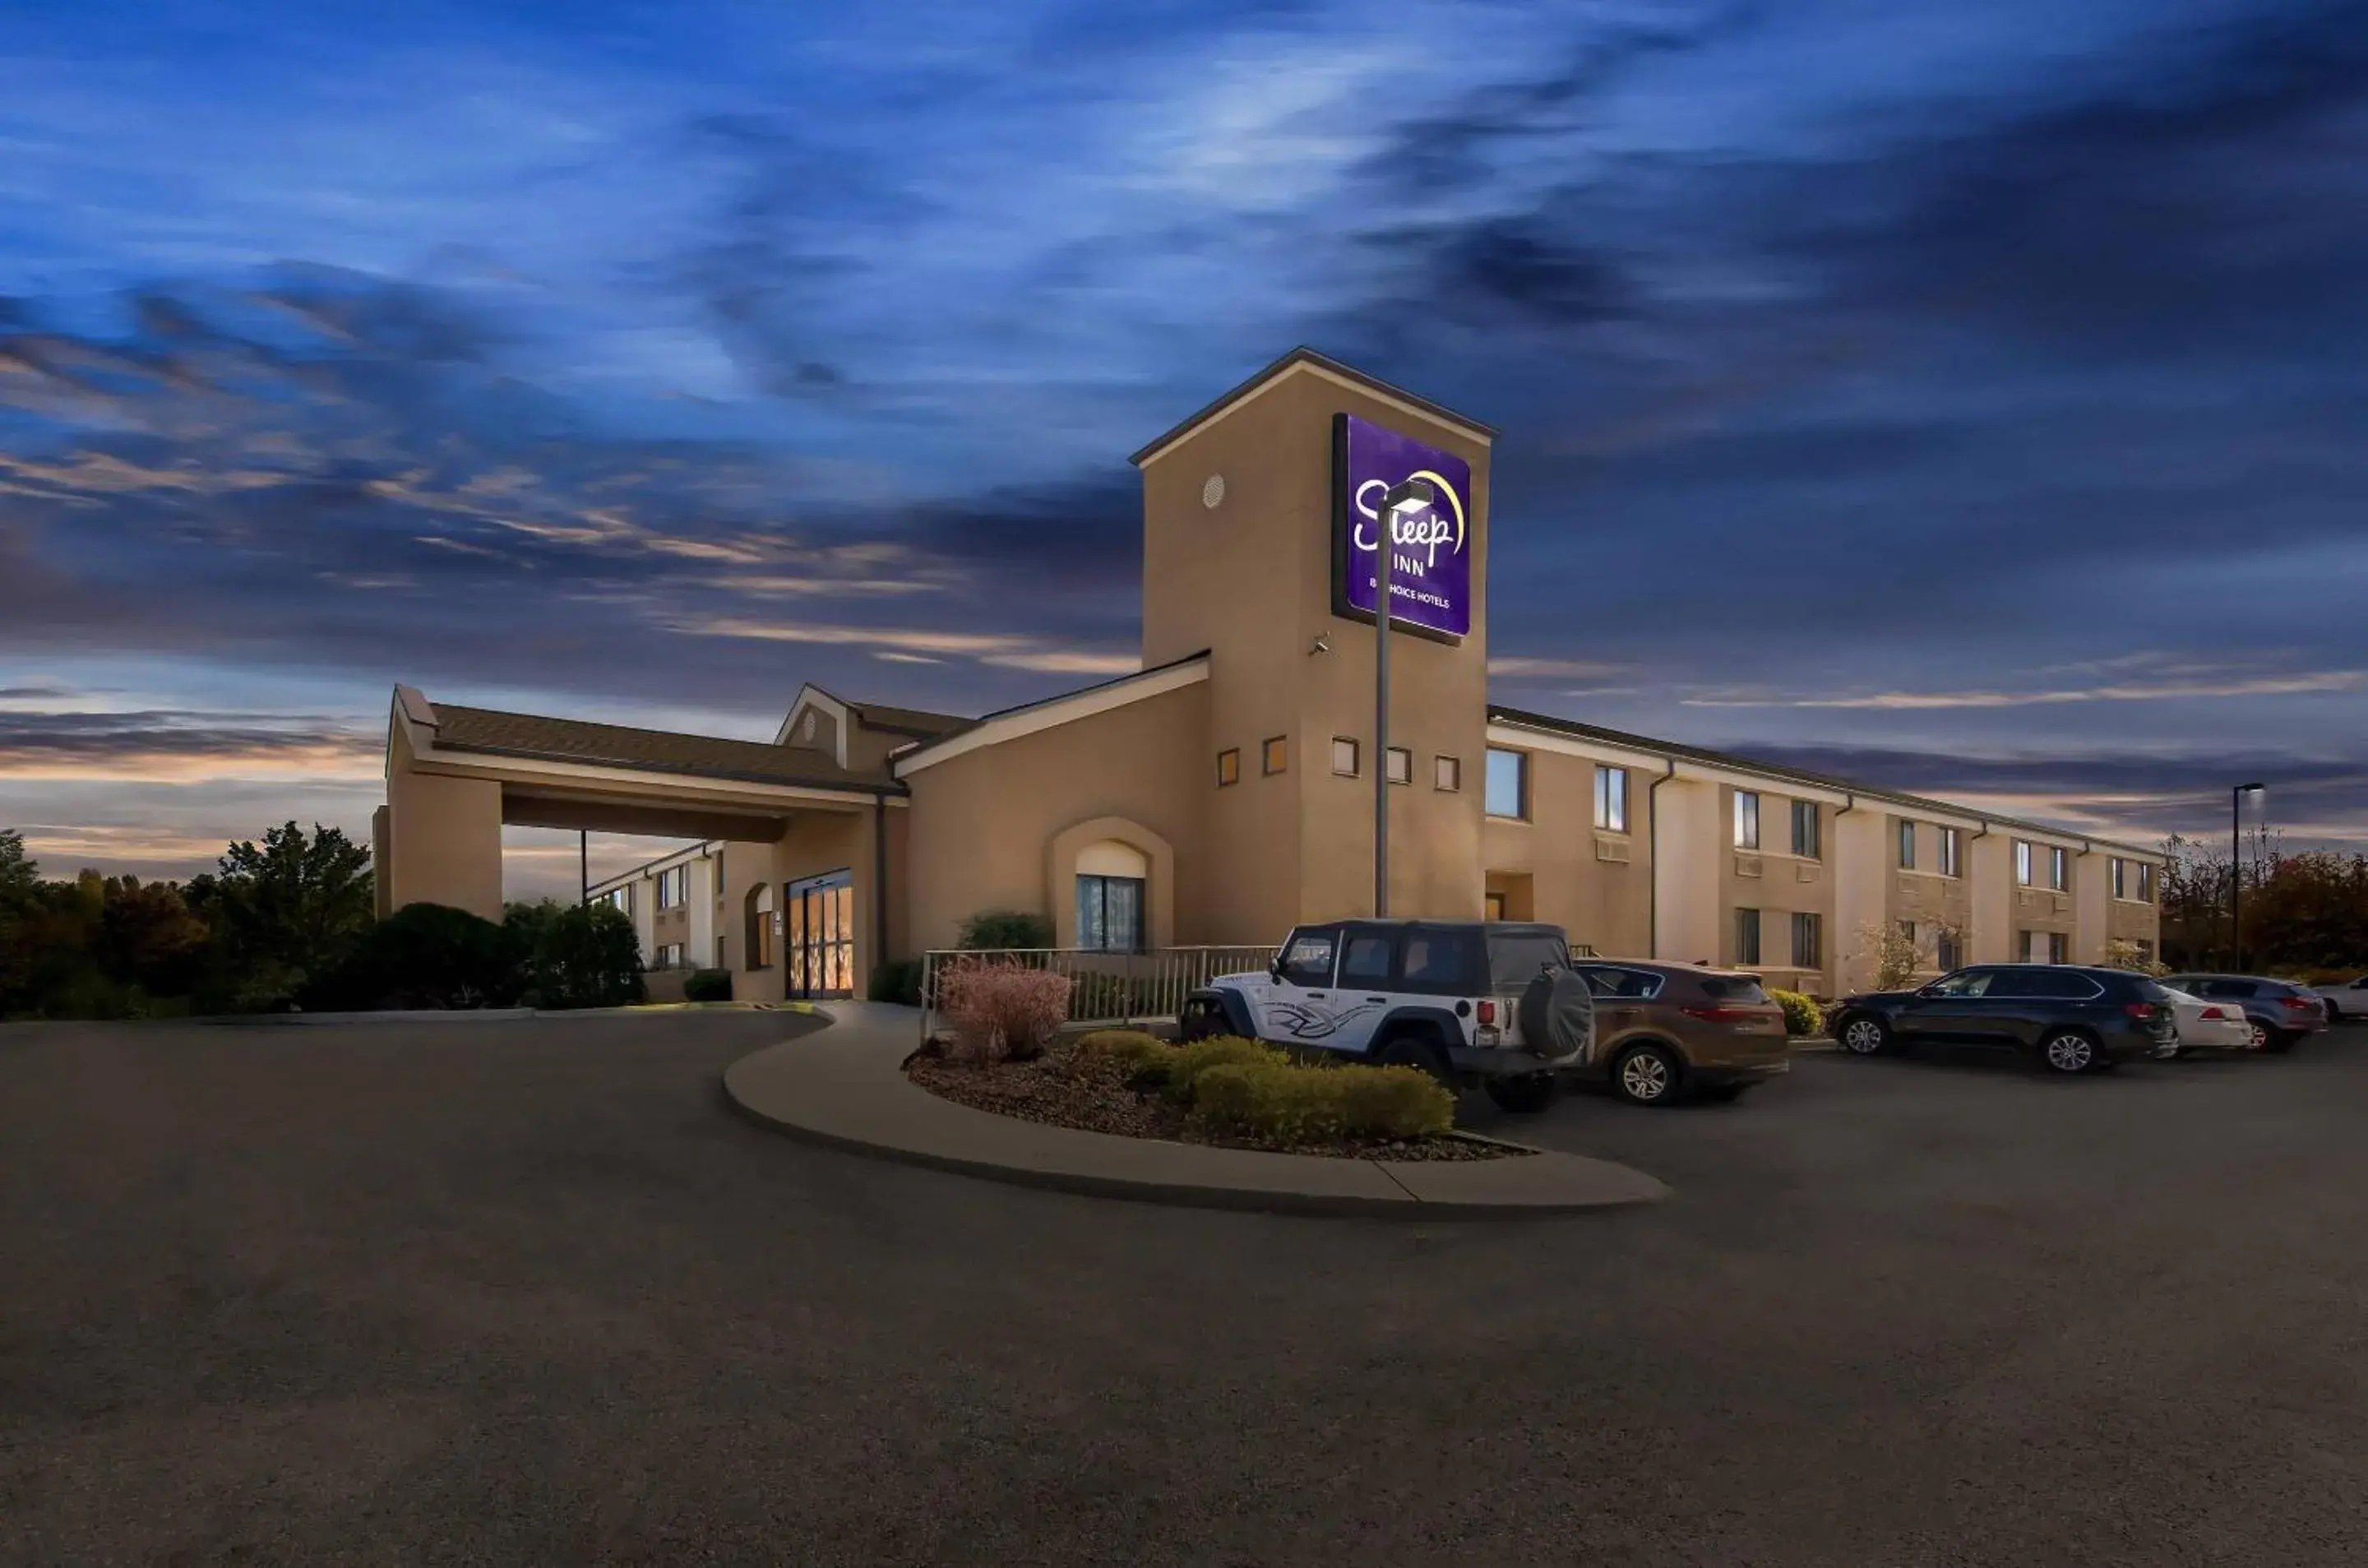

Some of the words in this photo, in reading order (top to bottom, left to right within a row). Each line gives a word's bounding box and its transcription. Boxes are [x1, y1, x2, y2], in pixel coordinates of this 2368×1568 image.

[1354, 479, 1454, 567] Sleep
[1394, 553, 1423, 577] INN
[1388, 583, 1417, 599] HOICE
[1417, 591, 1450, 609] HOTELS
